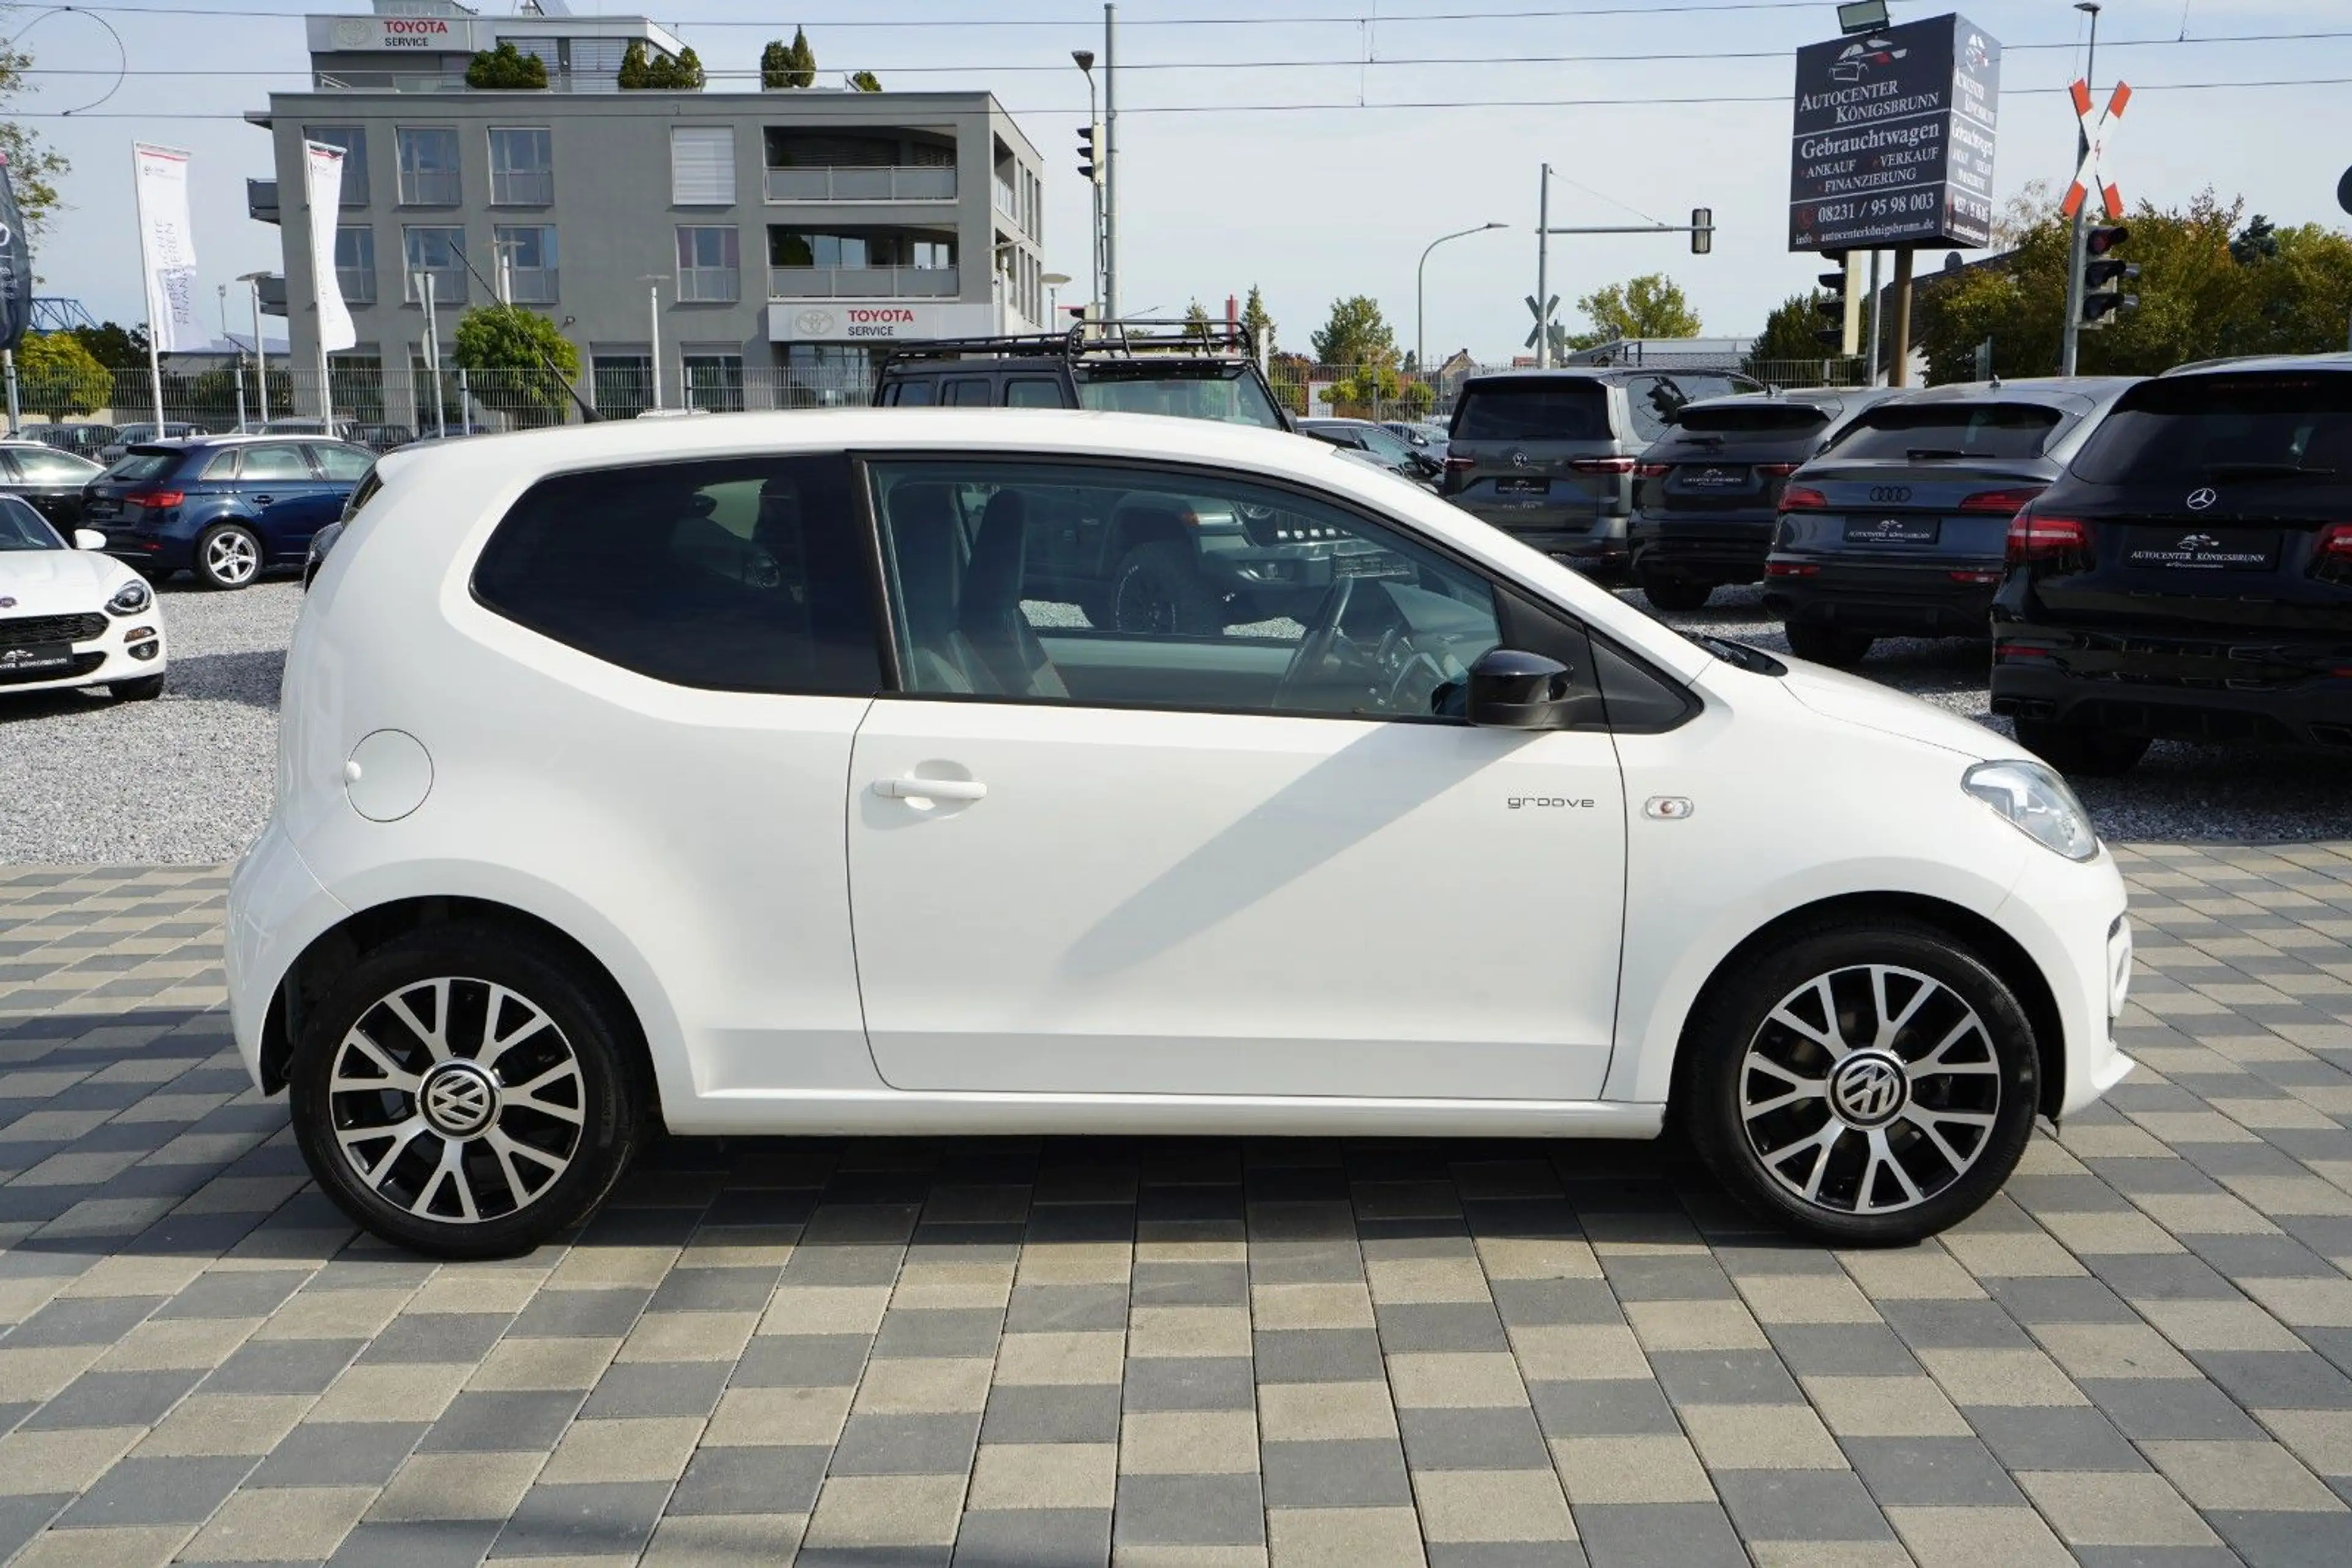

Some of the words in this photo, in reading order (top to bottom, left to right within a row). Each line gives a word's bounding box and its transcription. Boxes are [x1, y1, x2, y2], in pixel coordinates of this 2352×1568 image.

[383, 21, 448, 33] TOYOTA
[385, 37, 429, 47] SERVICE
[1800, 80, 1898, 111] AUTOCENTER
[1836, 93, 1939, 123] KÖNIGSBRUNN
[1801, 123, 1939, 159] Gebrauchtwagen
[1807, 159, 1856, 178] ANKAUF
[1880, 147, 1939, 167] VERKAUF
[1825, 168, 1917, 192] FINANZIERUNG
[1818, 205, 1854, 223] 08231
[1860, 202, 1867, 217] /
[1871, 198, 1887, 216] 95
[1890, 196, 1906, 213] 98
[1910, 192, 1934, 210] 003
[848, 309, 914, 322] TOYOTA
[848, 326, 894, 336] SERVICE
[2131, 551, 2192, 560] AUTOCENTER
[2195, 551, 2265, 562] KÖNIGSBRUNN
[1507, 797, 1595, 809] groove
[429, 1070, 490, 1129] VW
